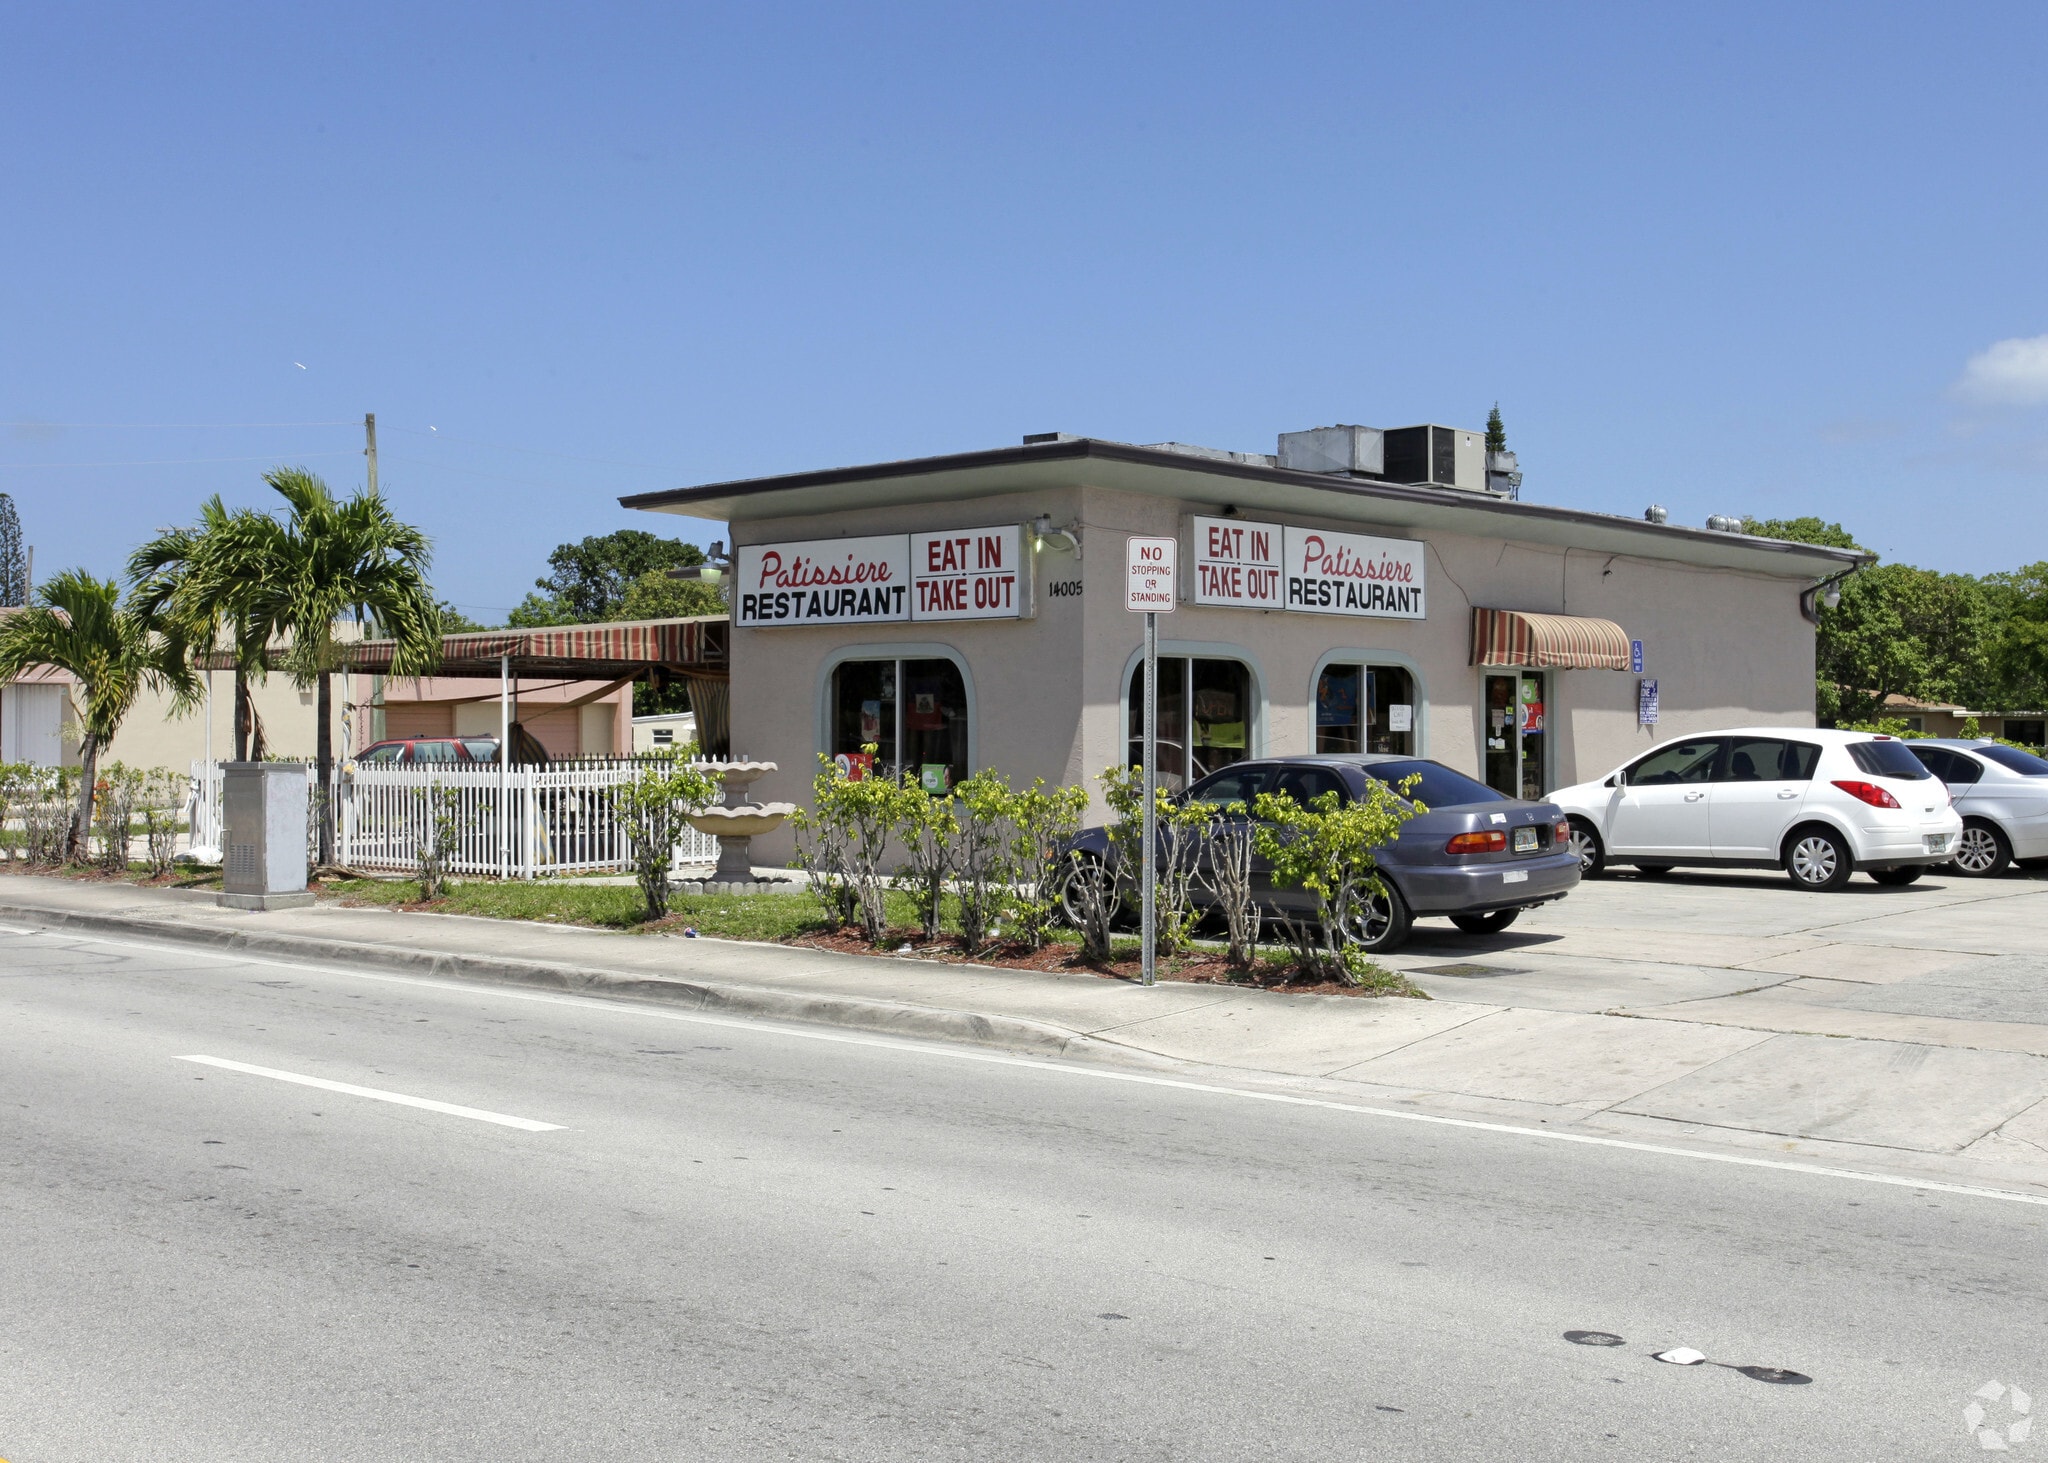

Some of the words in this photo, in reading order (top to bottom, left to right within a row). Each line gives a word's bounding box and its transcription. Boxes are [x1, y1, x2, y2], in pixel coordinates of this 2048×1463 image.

[928, 538, 970, 572] EAT
[977, 535, 1002, 569] IN
[1140, 546, 1162, 560] NO
[1208, 526, 1244, 560] EAT
[1251, 530, 1270, 562] IN
[1303, 535, 1414, 584] Patissiere
[760, 551, 893, 589] Patissiere
[1131, 565, 1171, 575] STOPPING
[1145, 579, 1157, 589] OR
[1198, 565, 1242, 598] TAKE
[1248, 568, 1279, 600] OUT
[742, 585, 906, 621] RESTAURANT
[916, 578, 968, 612] TAKE
[974, 576, 1015, 609] OUT
[1049, 580, 1083, 597] 14005
[1131, 592, 1171, 602] STANDING
[1289, 577, 1422, 613] RESTAURANT
